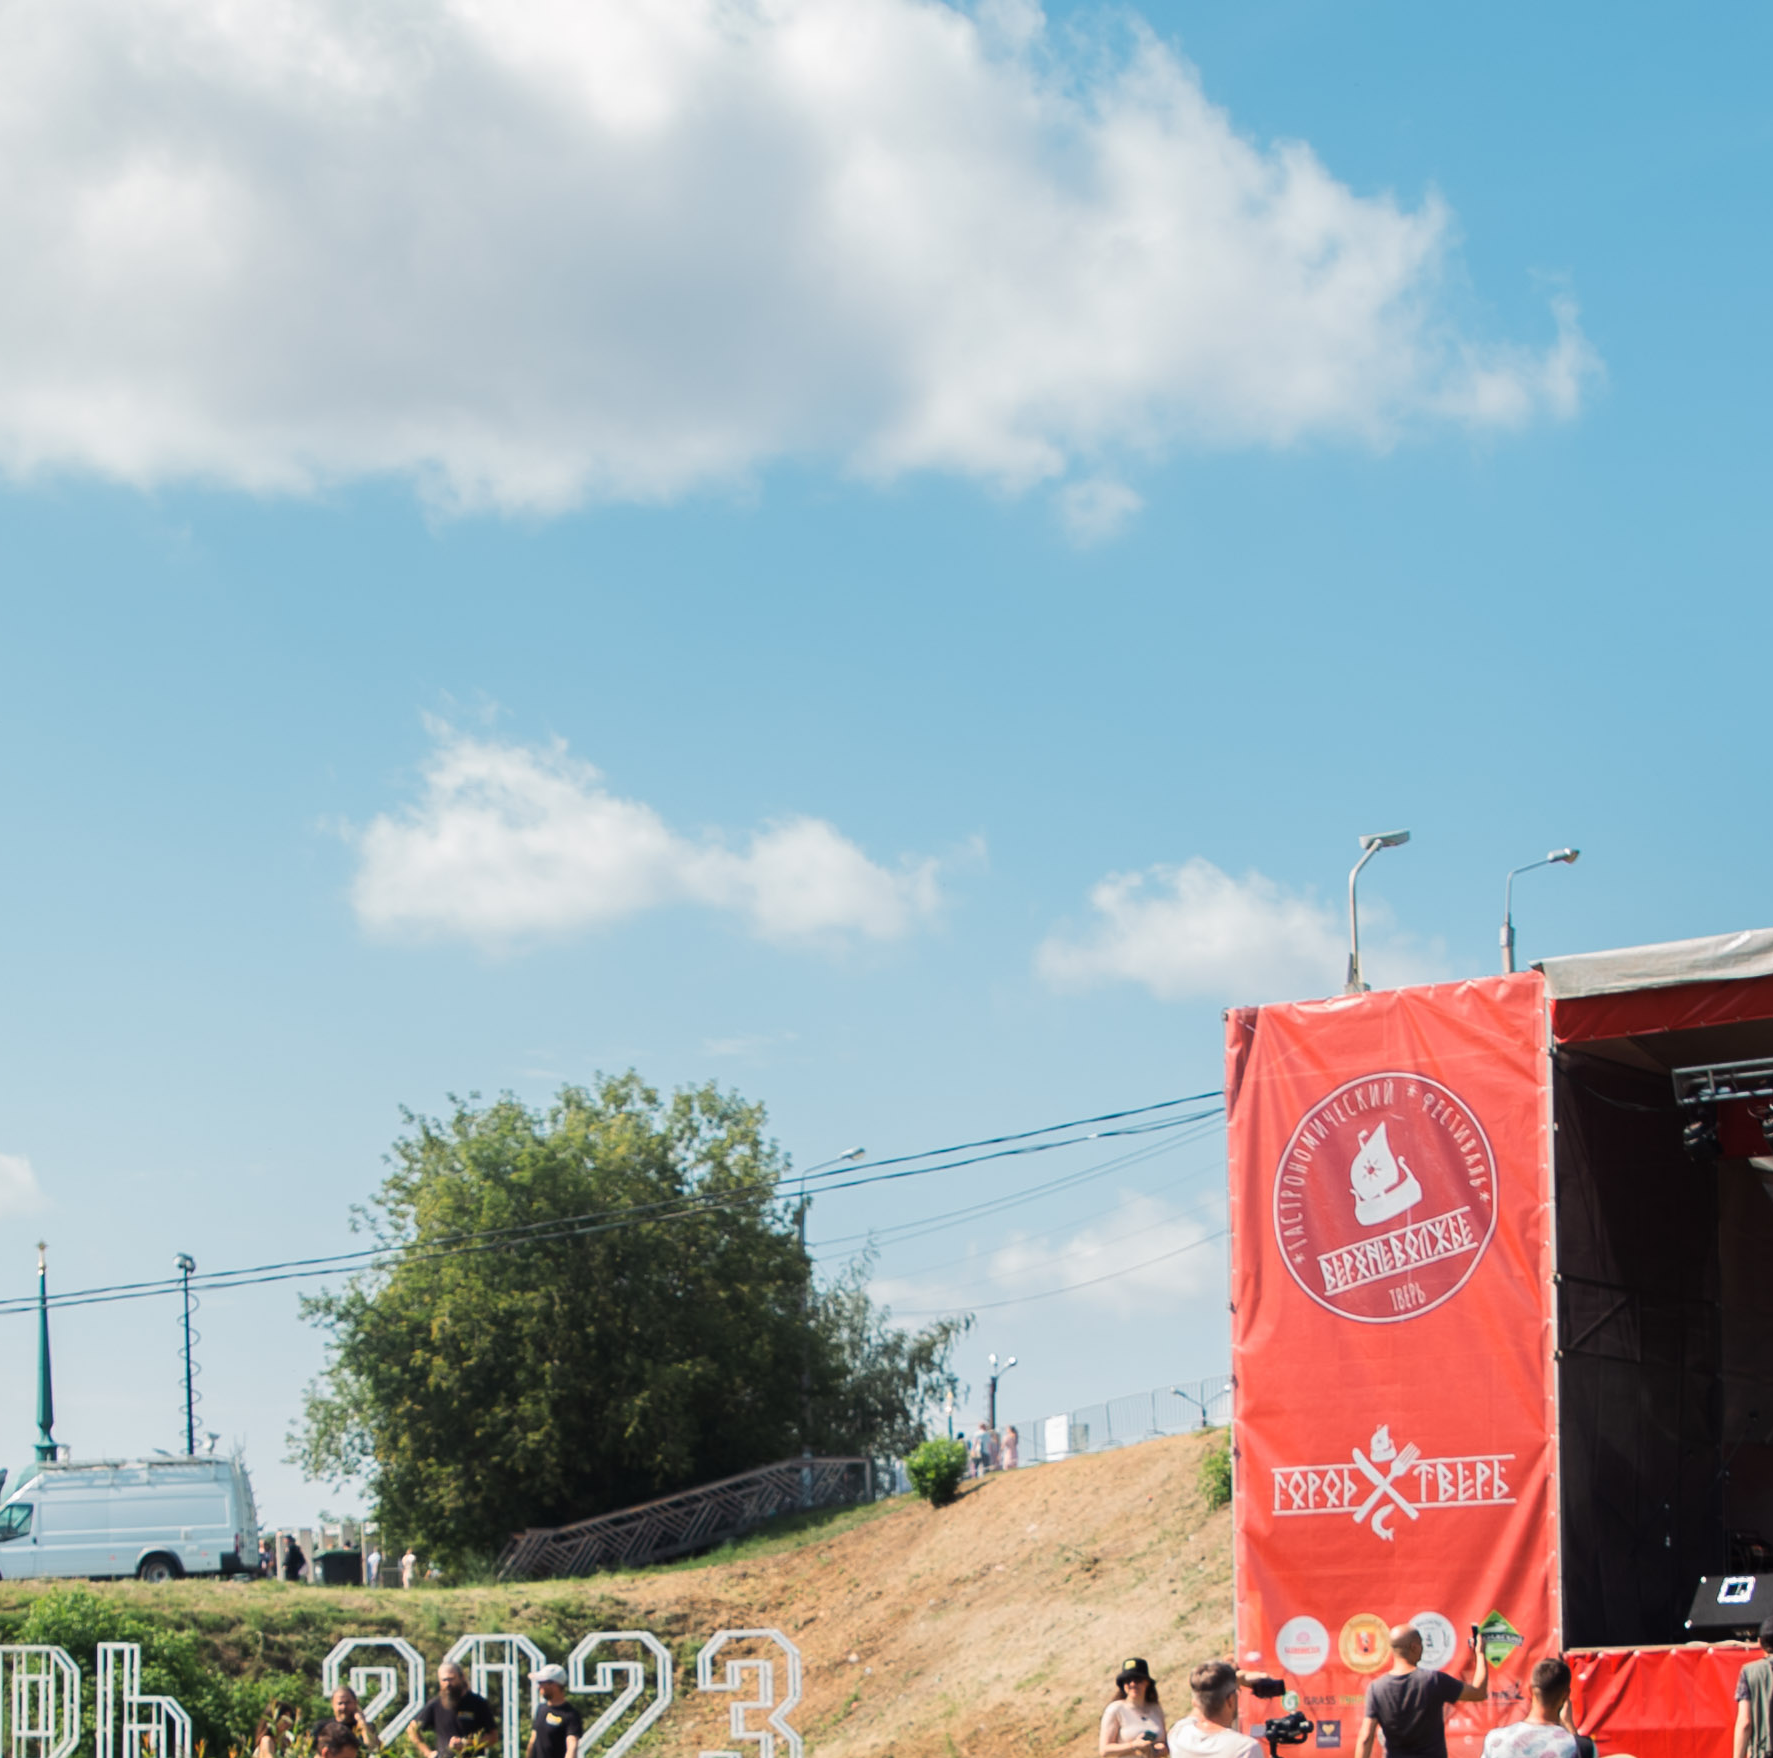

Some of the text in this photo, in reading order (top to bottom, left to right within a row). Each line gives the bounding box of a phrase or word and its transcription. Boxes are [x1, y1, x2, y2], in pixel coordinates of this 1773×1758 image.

[1278, 1079, 1487, 1252] ГАСТРОНОМИЧЕСКИЙ ФЕСТИВАЛЬ
[1388, 1285, 1427, 1313] ТВЕРЬ
[1413, 1459, 1509, 1502] ТВЕРЬ
